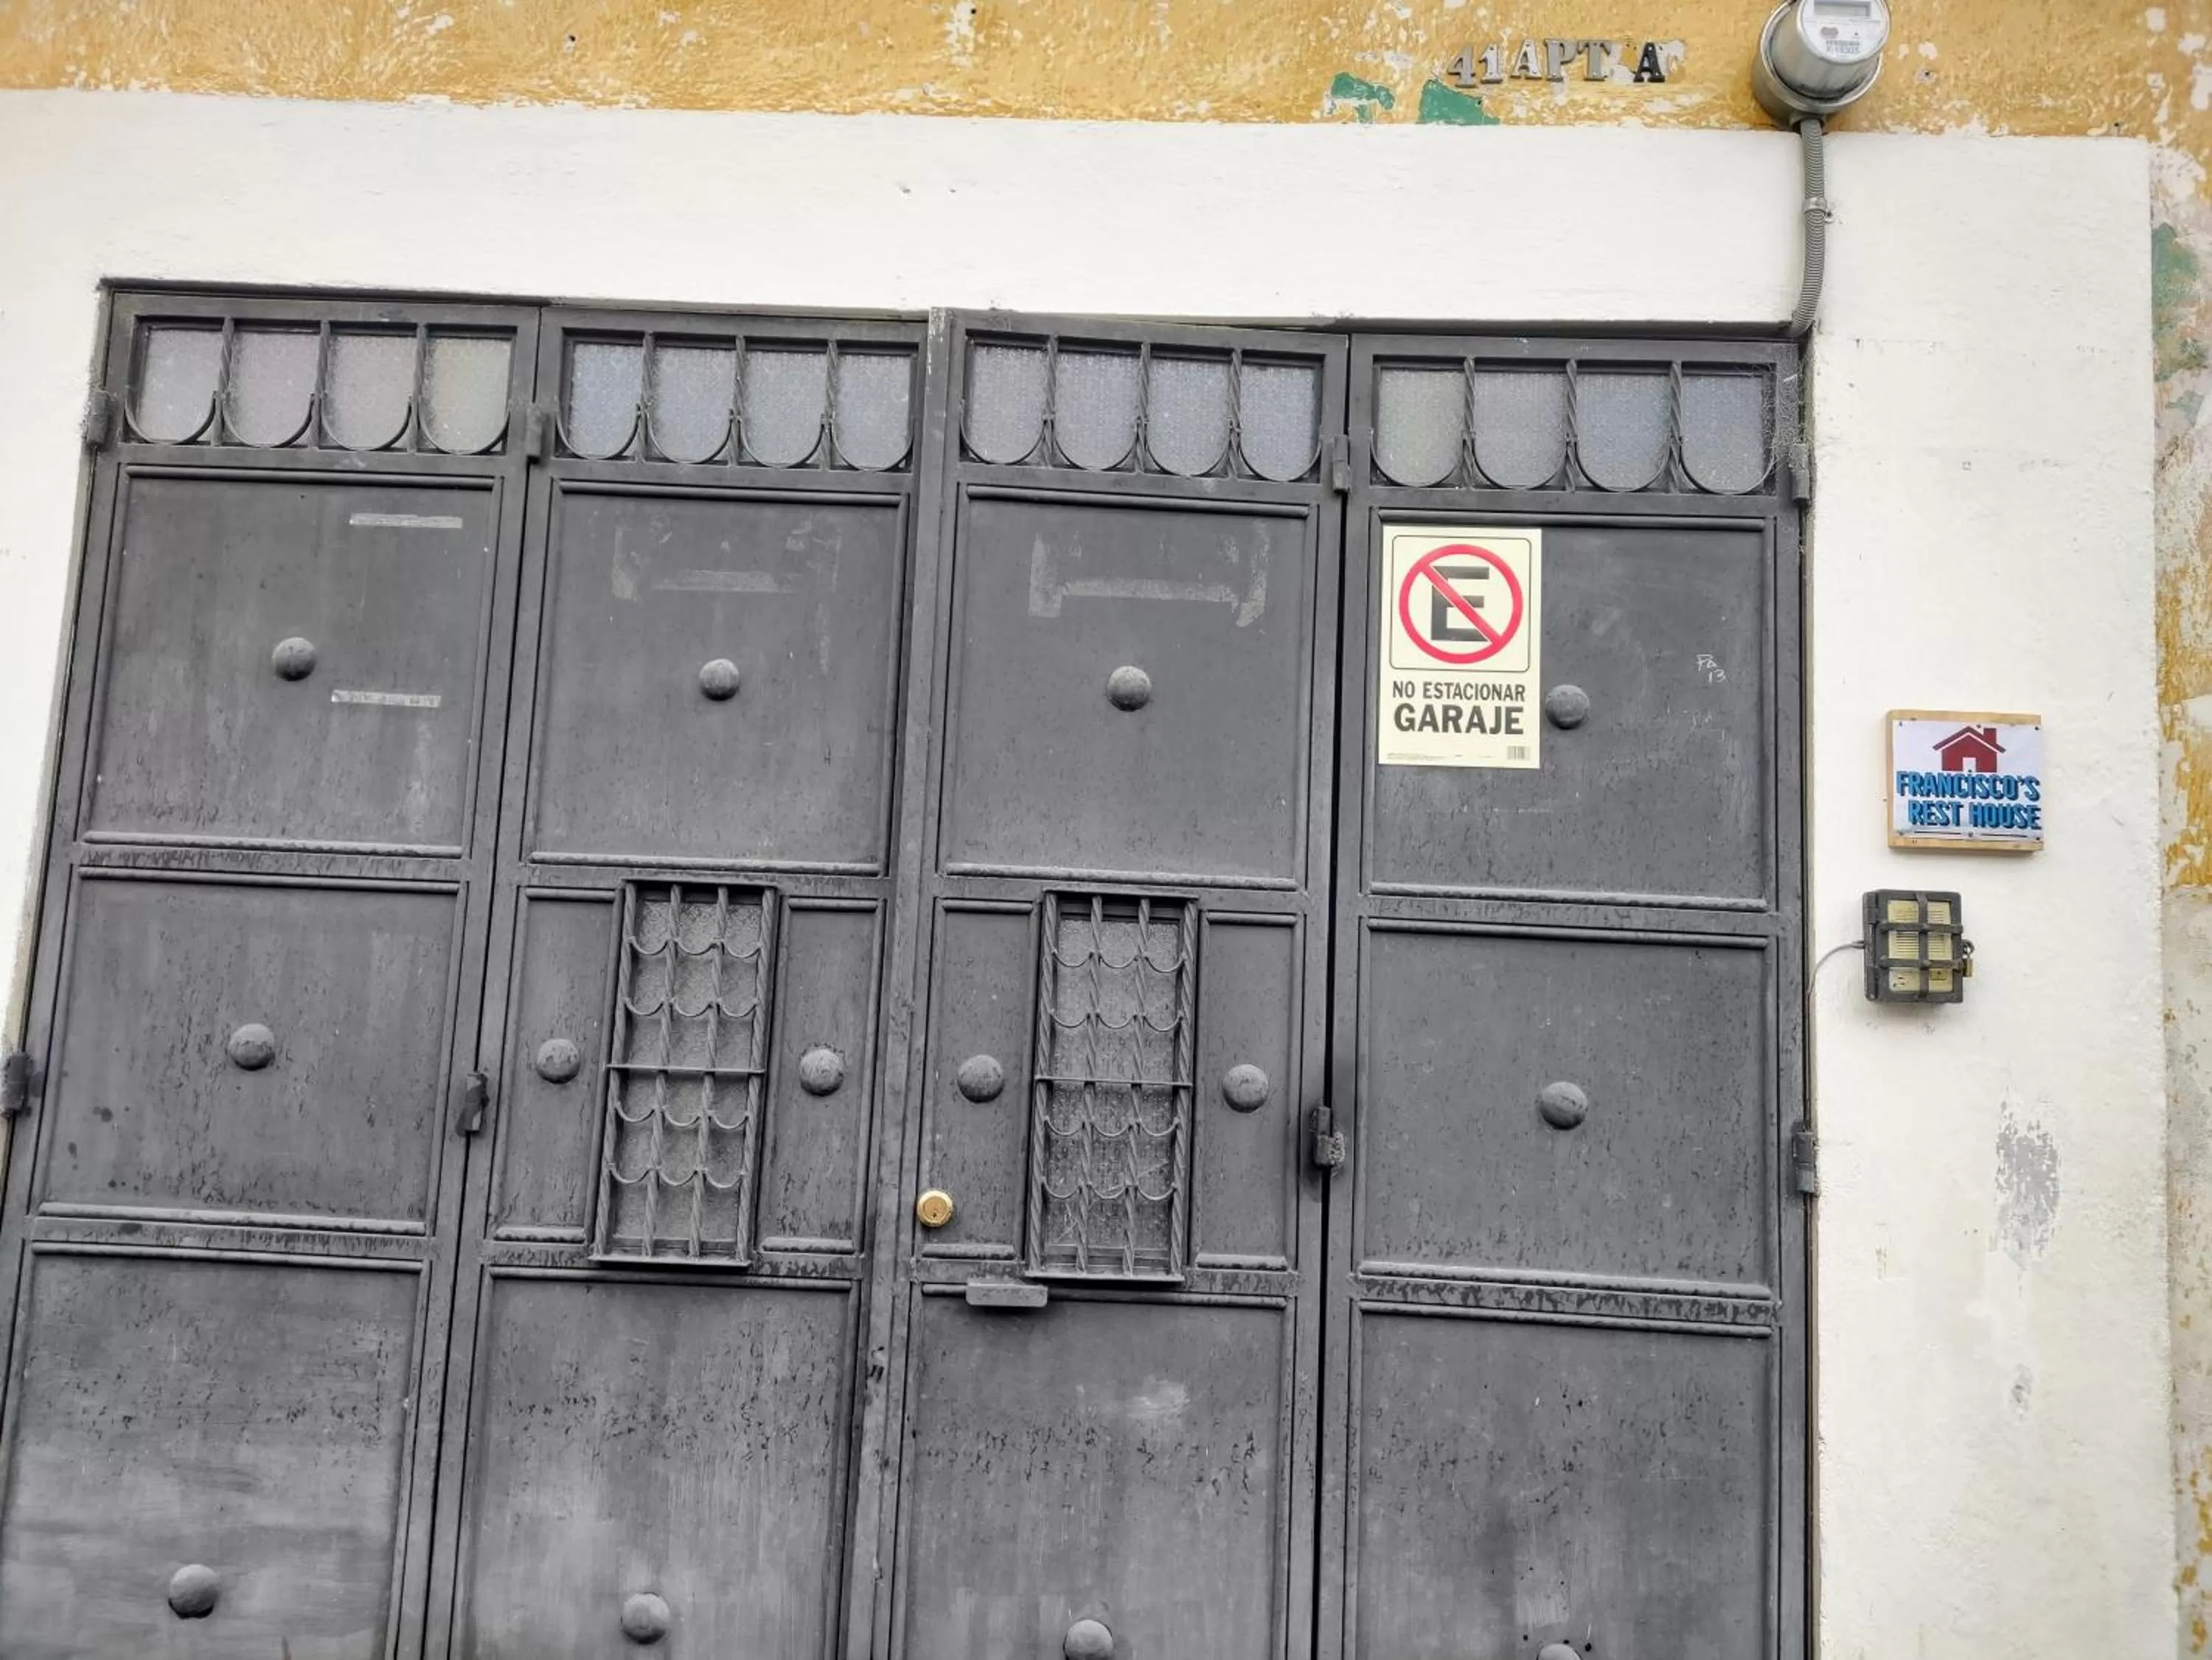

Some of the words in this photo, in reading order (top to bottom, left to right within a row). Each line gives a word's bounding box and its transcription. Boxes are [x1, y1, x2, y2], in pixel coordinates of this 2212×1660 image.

[1633, 42, 1666, 83] A
[1393, 680, 1416, 699] NO
[1422, 681, 1526, 702] ESTACIONAR
[1394, 703, 1524, 735] GARAJE
[1908, 800, 1964, 827] REST
[1969, 802, 2042, 830] HOUSE
